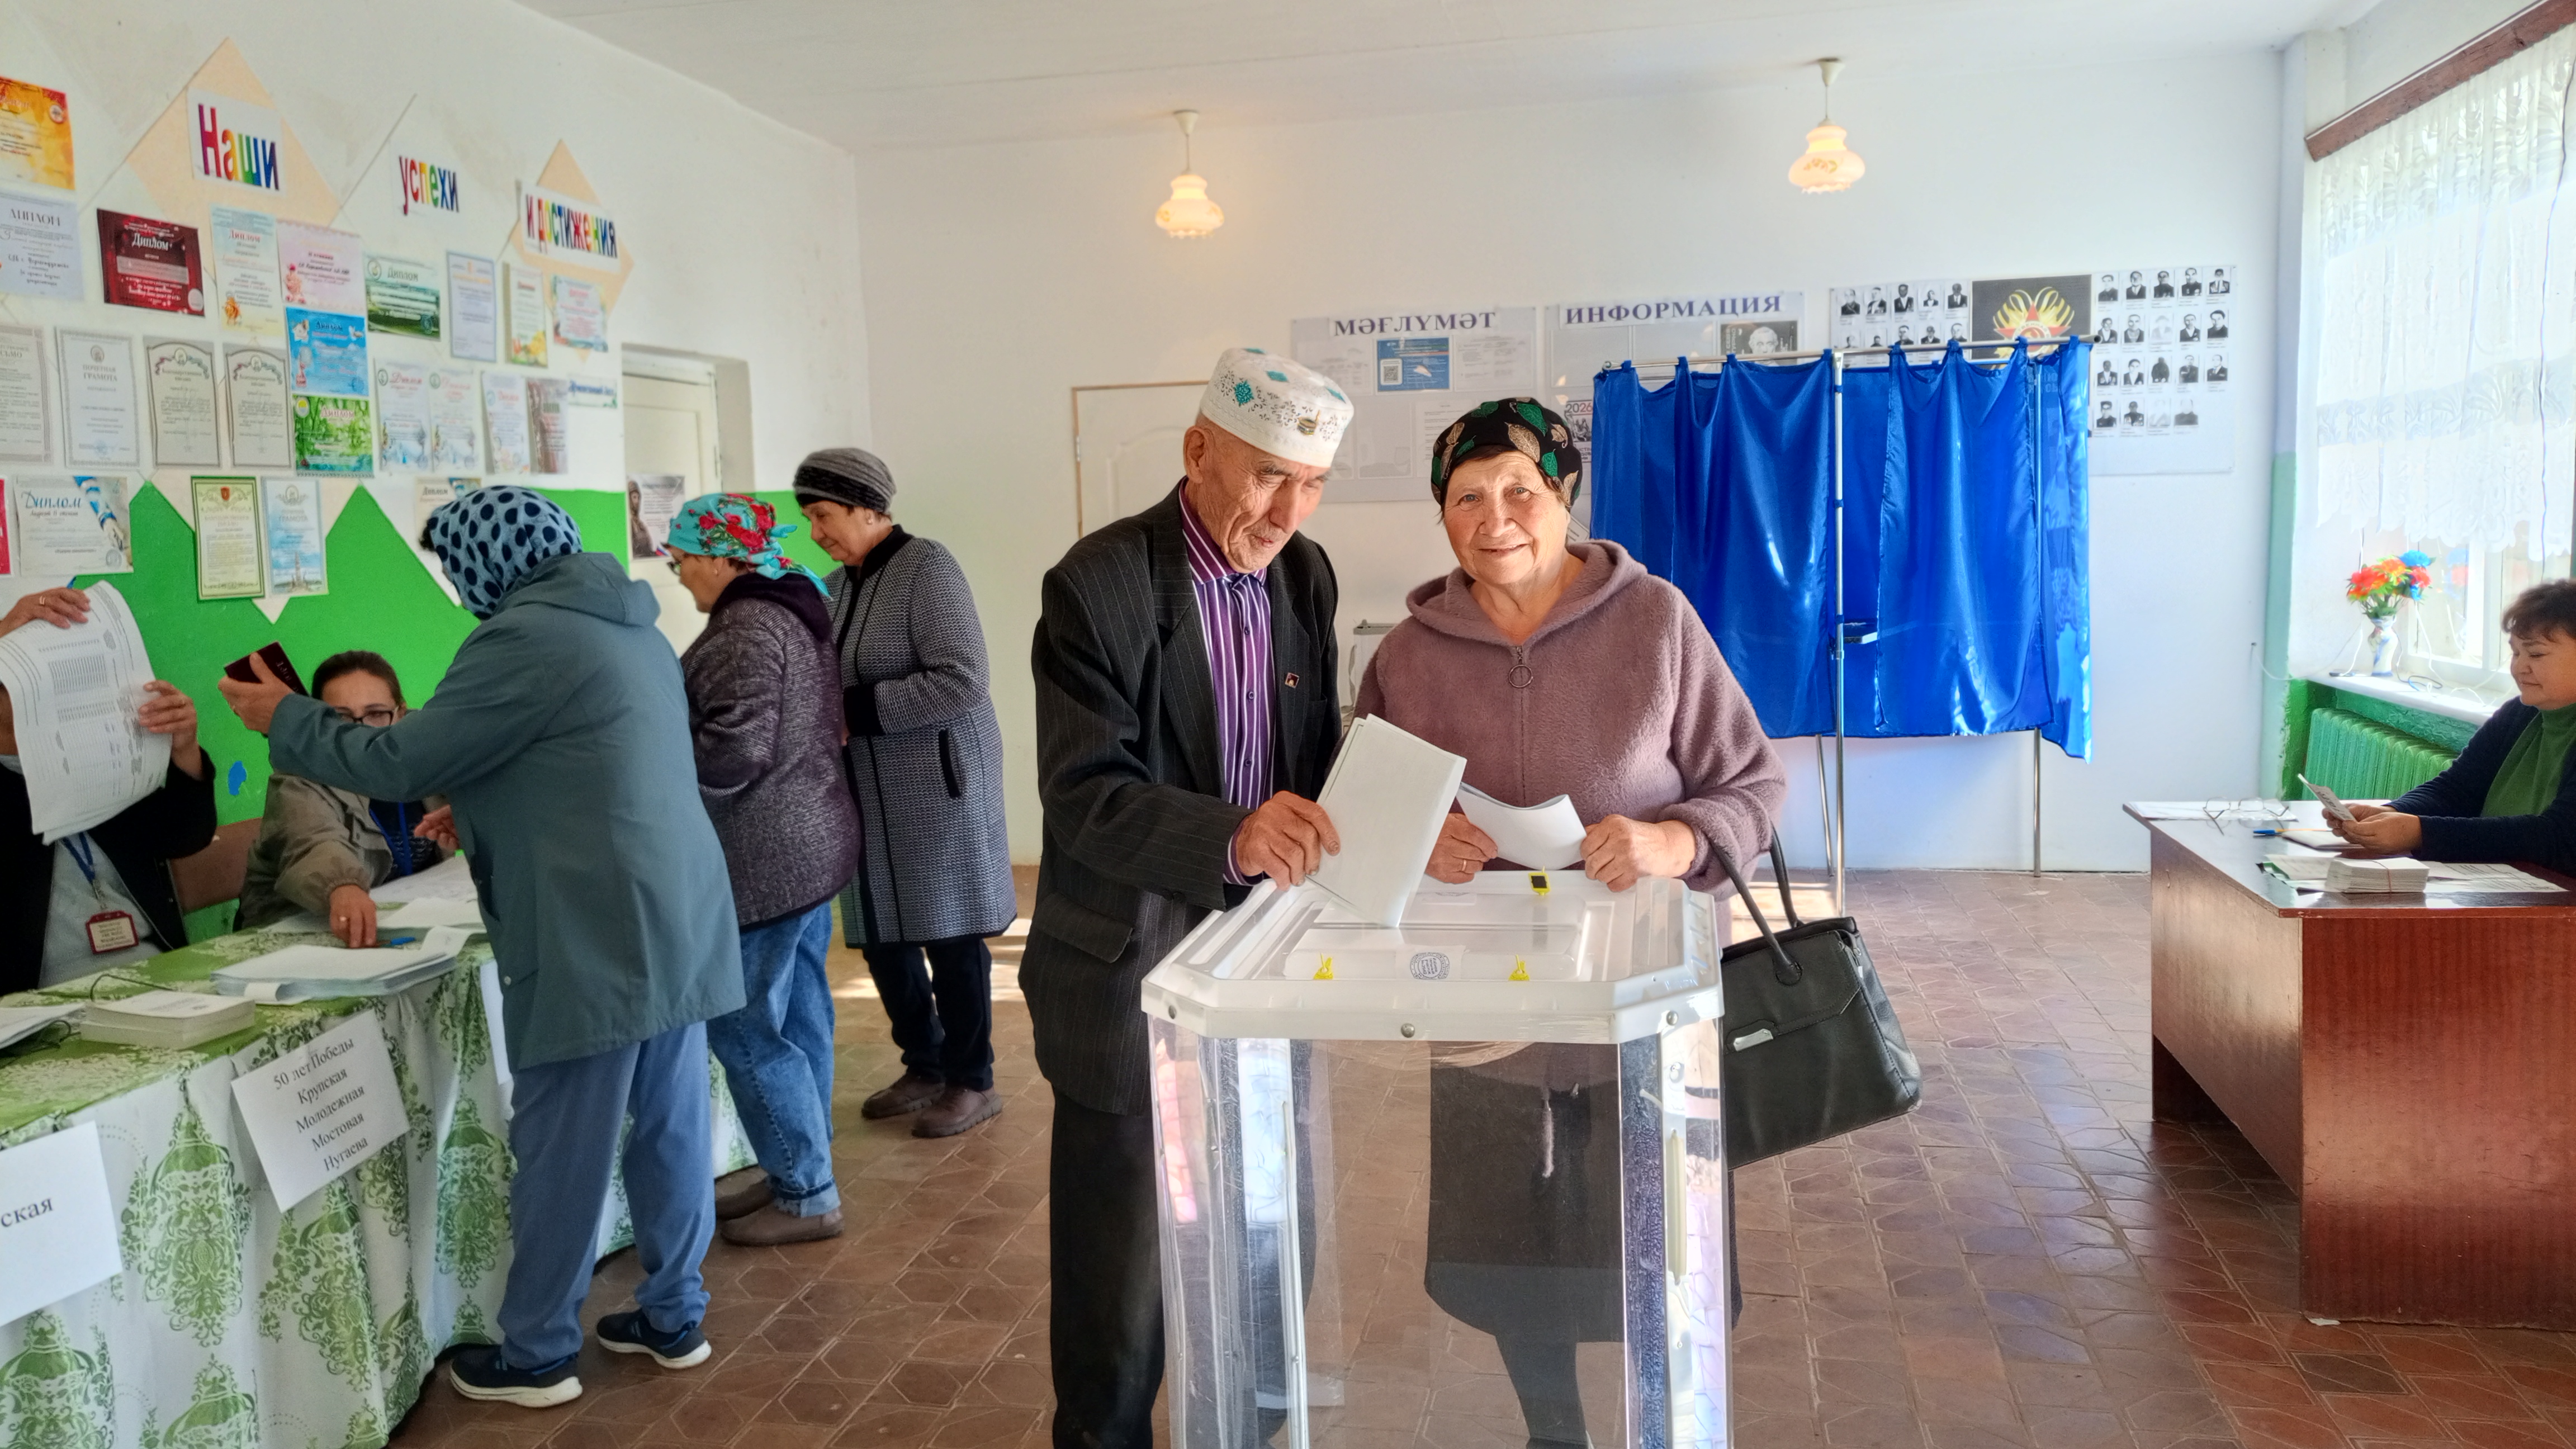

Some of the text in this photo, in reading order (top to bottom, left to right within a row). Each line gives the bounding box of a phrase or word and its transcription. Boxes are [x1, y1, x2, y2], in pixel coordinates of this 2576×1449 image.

[197, 103, 280, 191] Наши
[399, 155, 460, 216] успехи
[10, 209, 61, 226] ДИПЛОМ
[537, 197, 618, 259] достижения
[131, 232, 169, 252] Диплом
[387, 267, 419, 281] Диплом
[1565, 295, 1782, 326] ИНФОРМАЦИЯ
[83, 373, 118, 382] ГРАМОТА
[1566, 402, 1592, 413] 2026
[21, 489, 81, 509] Диплом
[273, 1038, 354, 1090] 50 лет Победы
[297, 1068, 348, 1105] Крупская
[296, 1086, 364, 1134] Молодежная
[311, 1112, 364, 1152] Мостовая
[324, 1137, 368, 1171] Нугаева
[1, 1197, 53, 1227] ская
